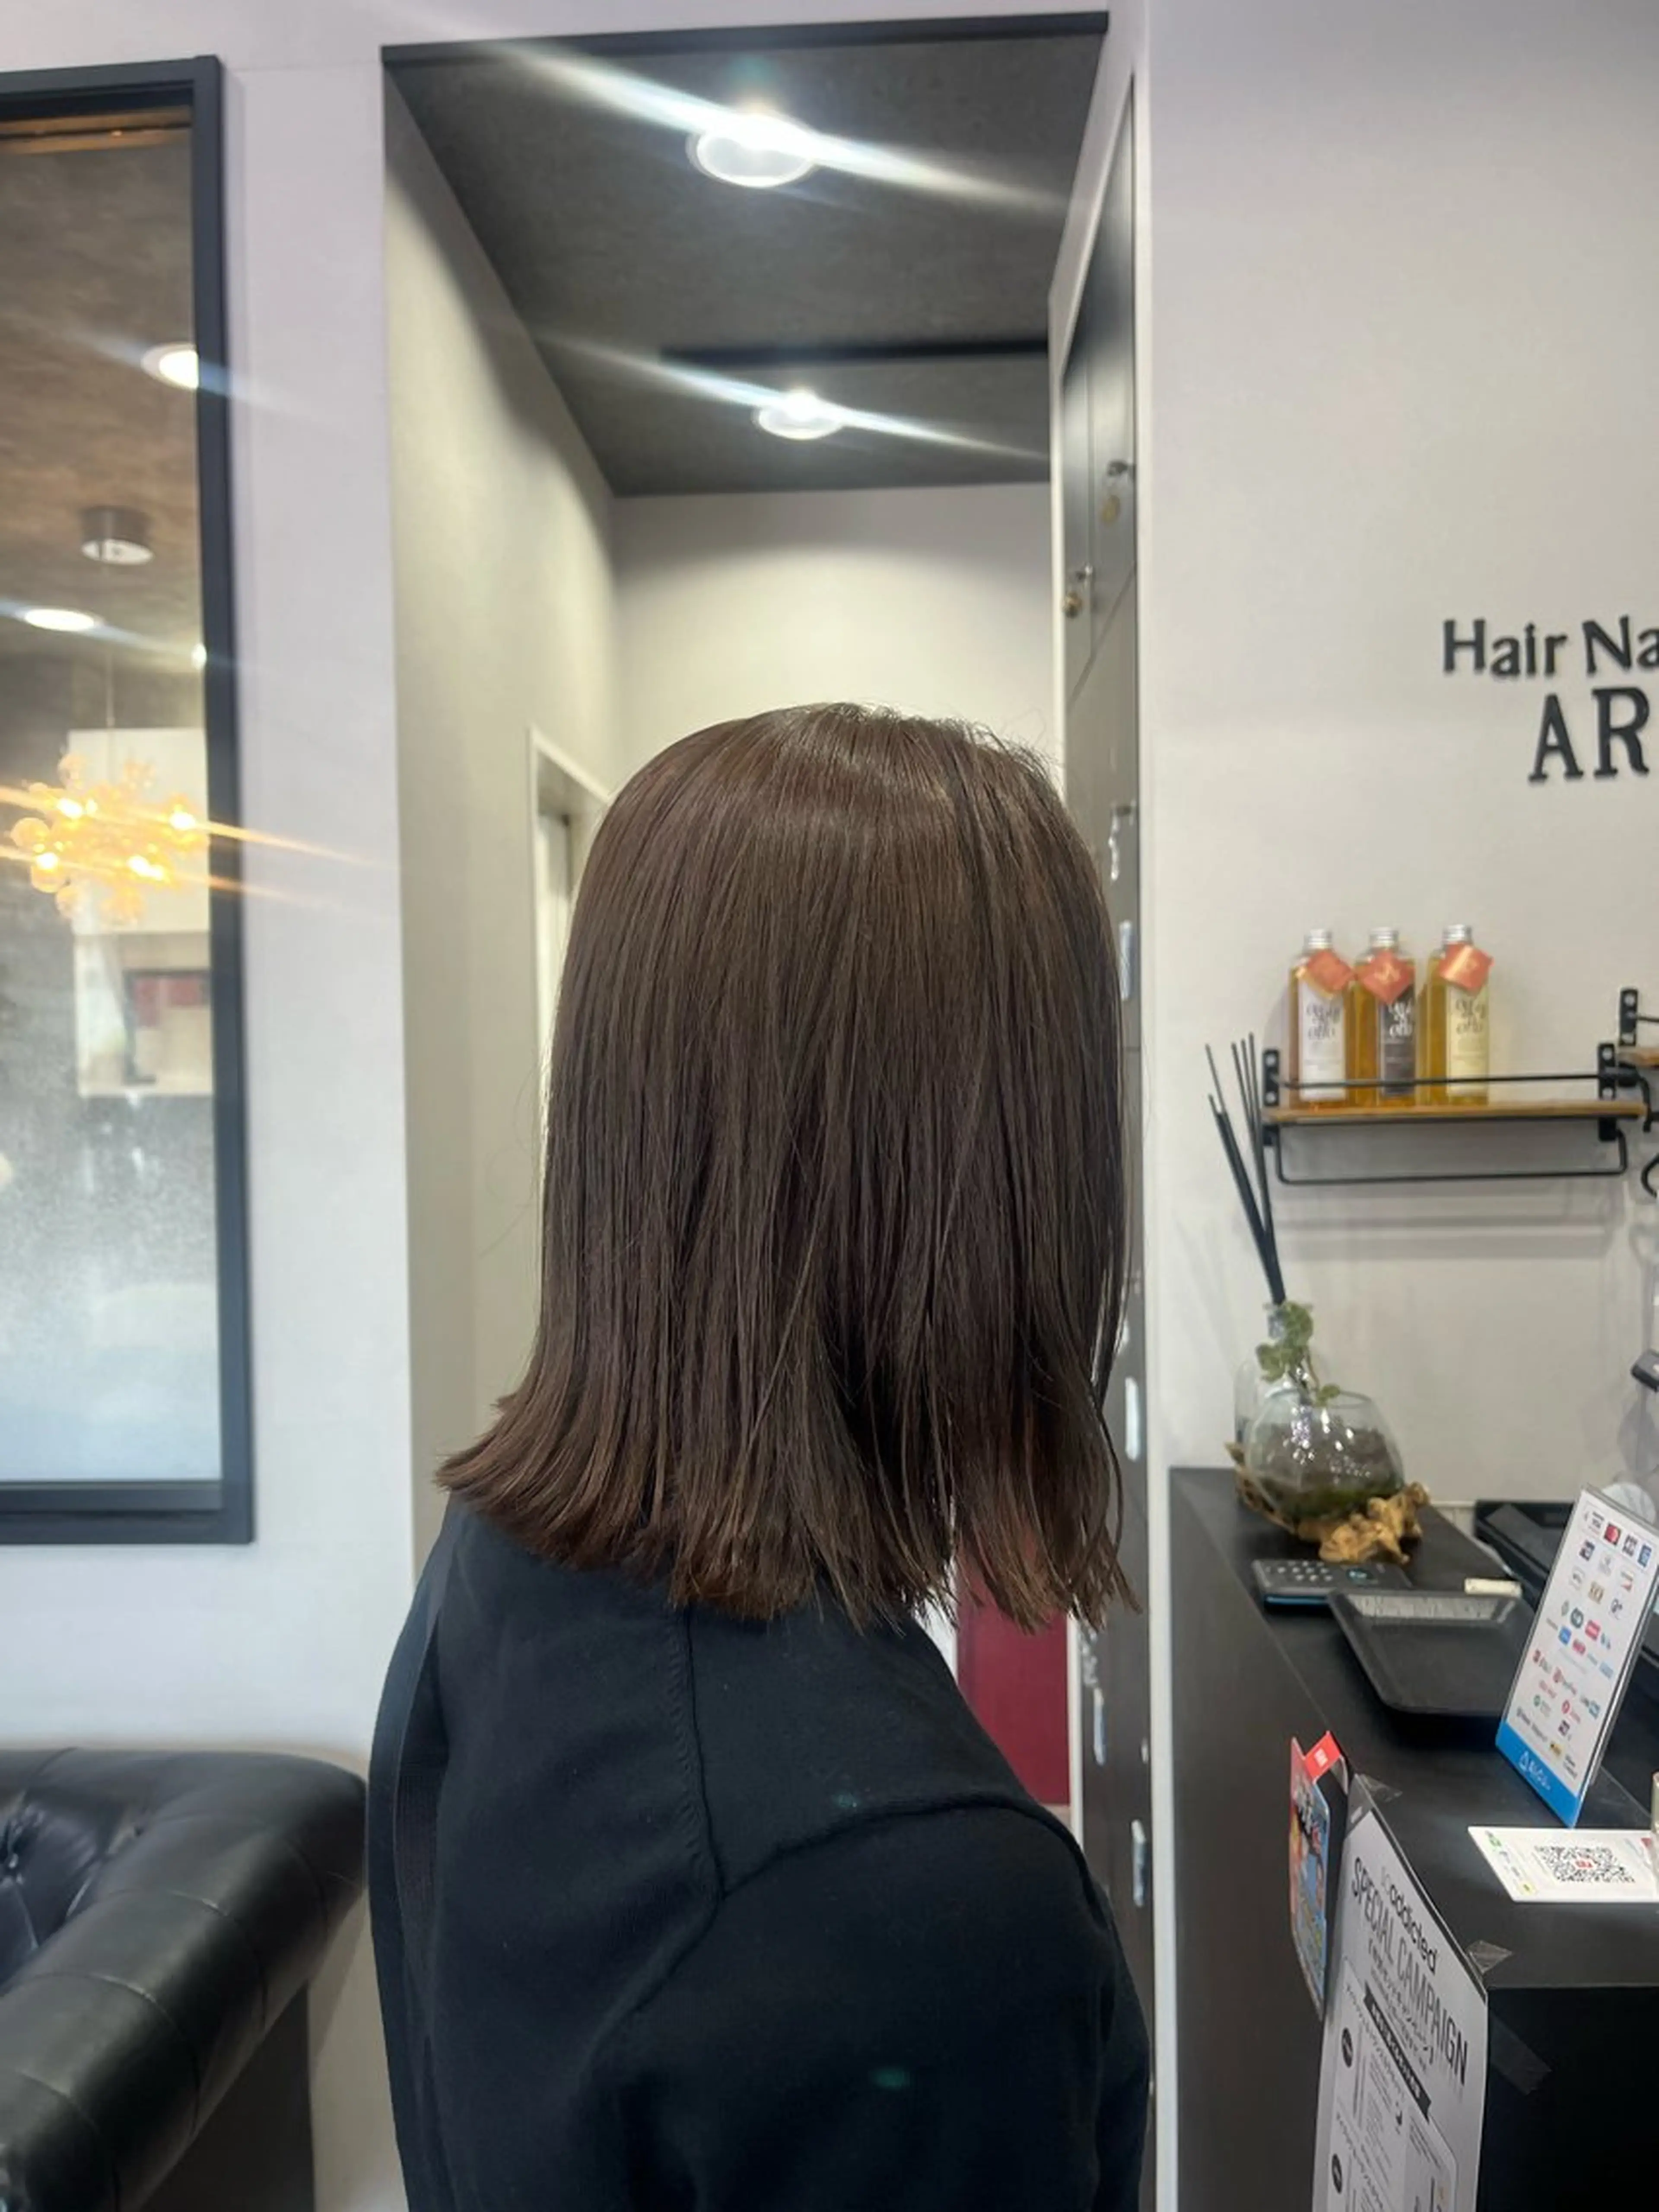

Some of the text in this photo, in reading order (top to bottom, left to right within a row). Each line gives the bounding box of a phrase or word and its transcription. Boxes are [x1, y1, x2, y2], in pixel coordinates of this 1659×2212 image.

[1443, 615, 1659, 678] Hair Na
[1528, 686, 1650, 783] AR
[1352, 1856, 1394, 1965] SPECIAL
[1397, 1936, 1468, 2086] CAMPAIGN
